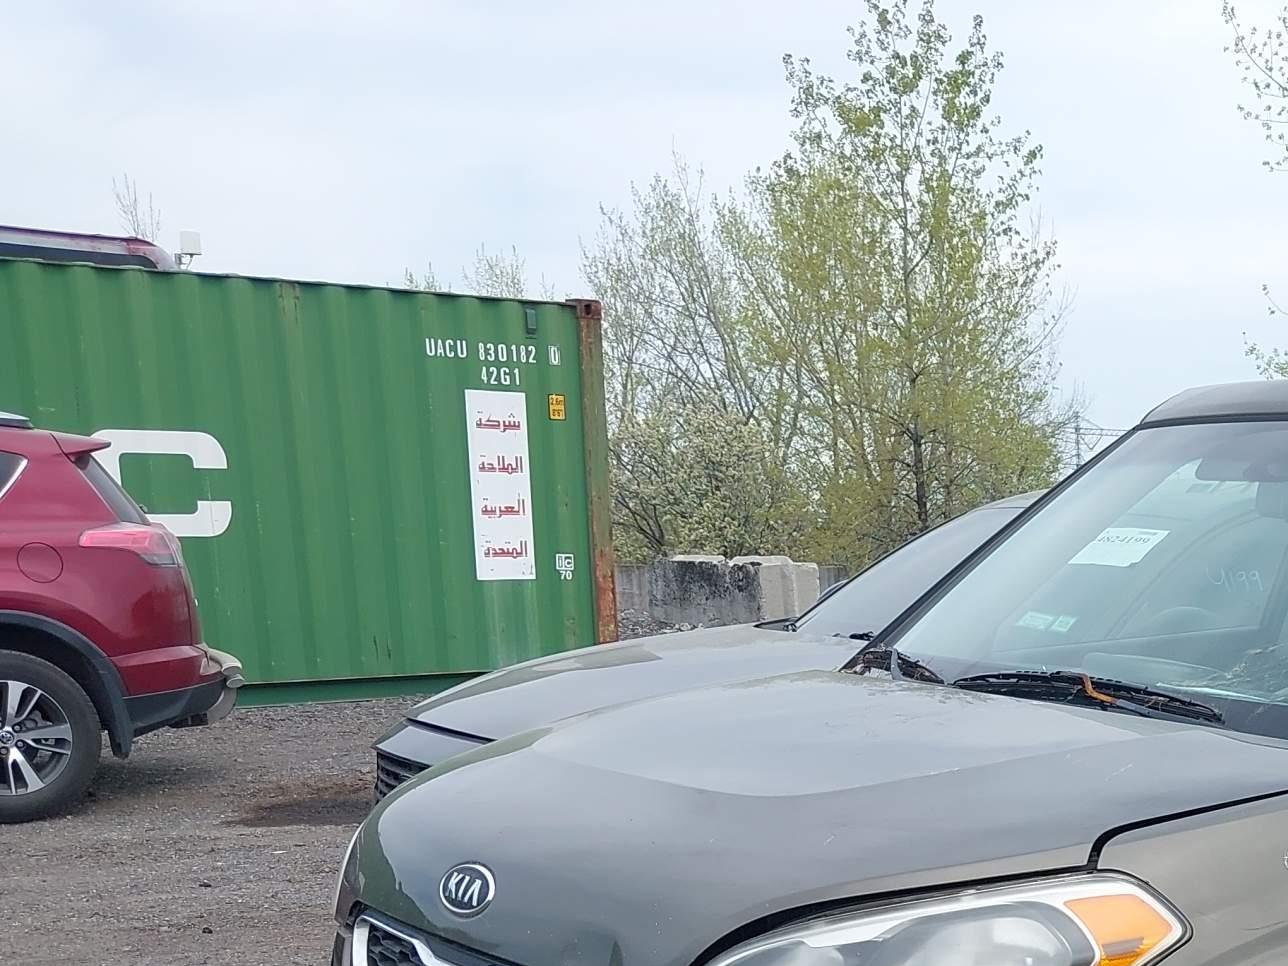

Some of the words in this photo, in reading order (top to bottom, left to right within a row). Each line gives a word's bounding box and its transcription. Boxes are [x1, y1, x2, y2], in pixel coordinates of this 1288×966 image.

[425, 338, 467, 358] UACU
[478, 342, 537, 364] 830182
[481, 366, 520, 386] 42G1
[475, 410, 521, 433] شركة
[478, 454, 524, 475] الملاحة
[559, 570, 573, 581] 70
[445, 871, 483, 907] KIA
